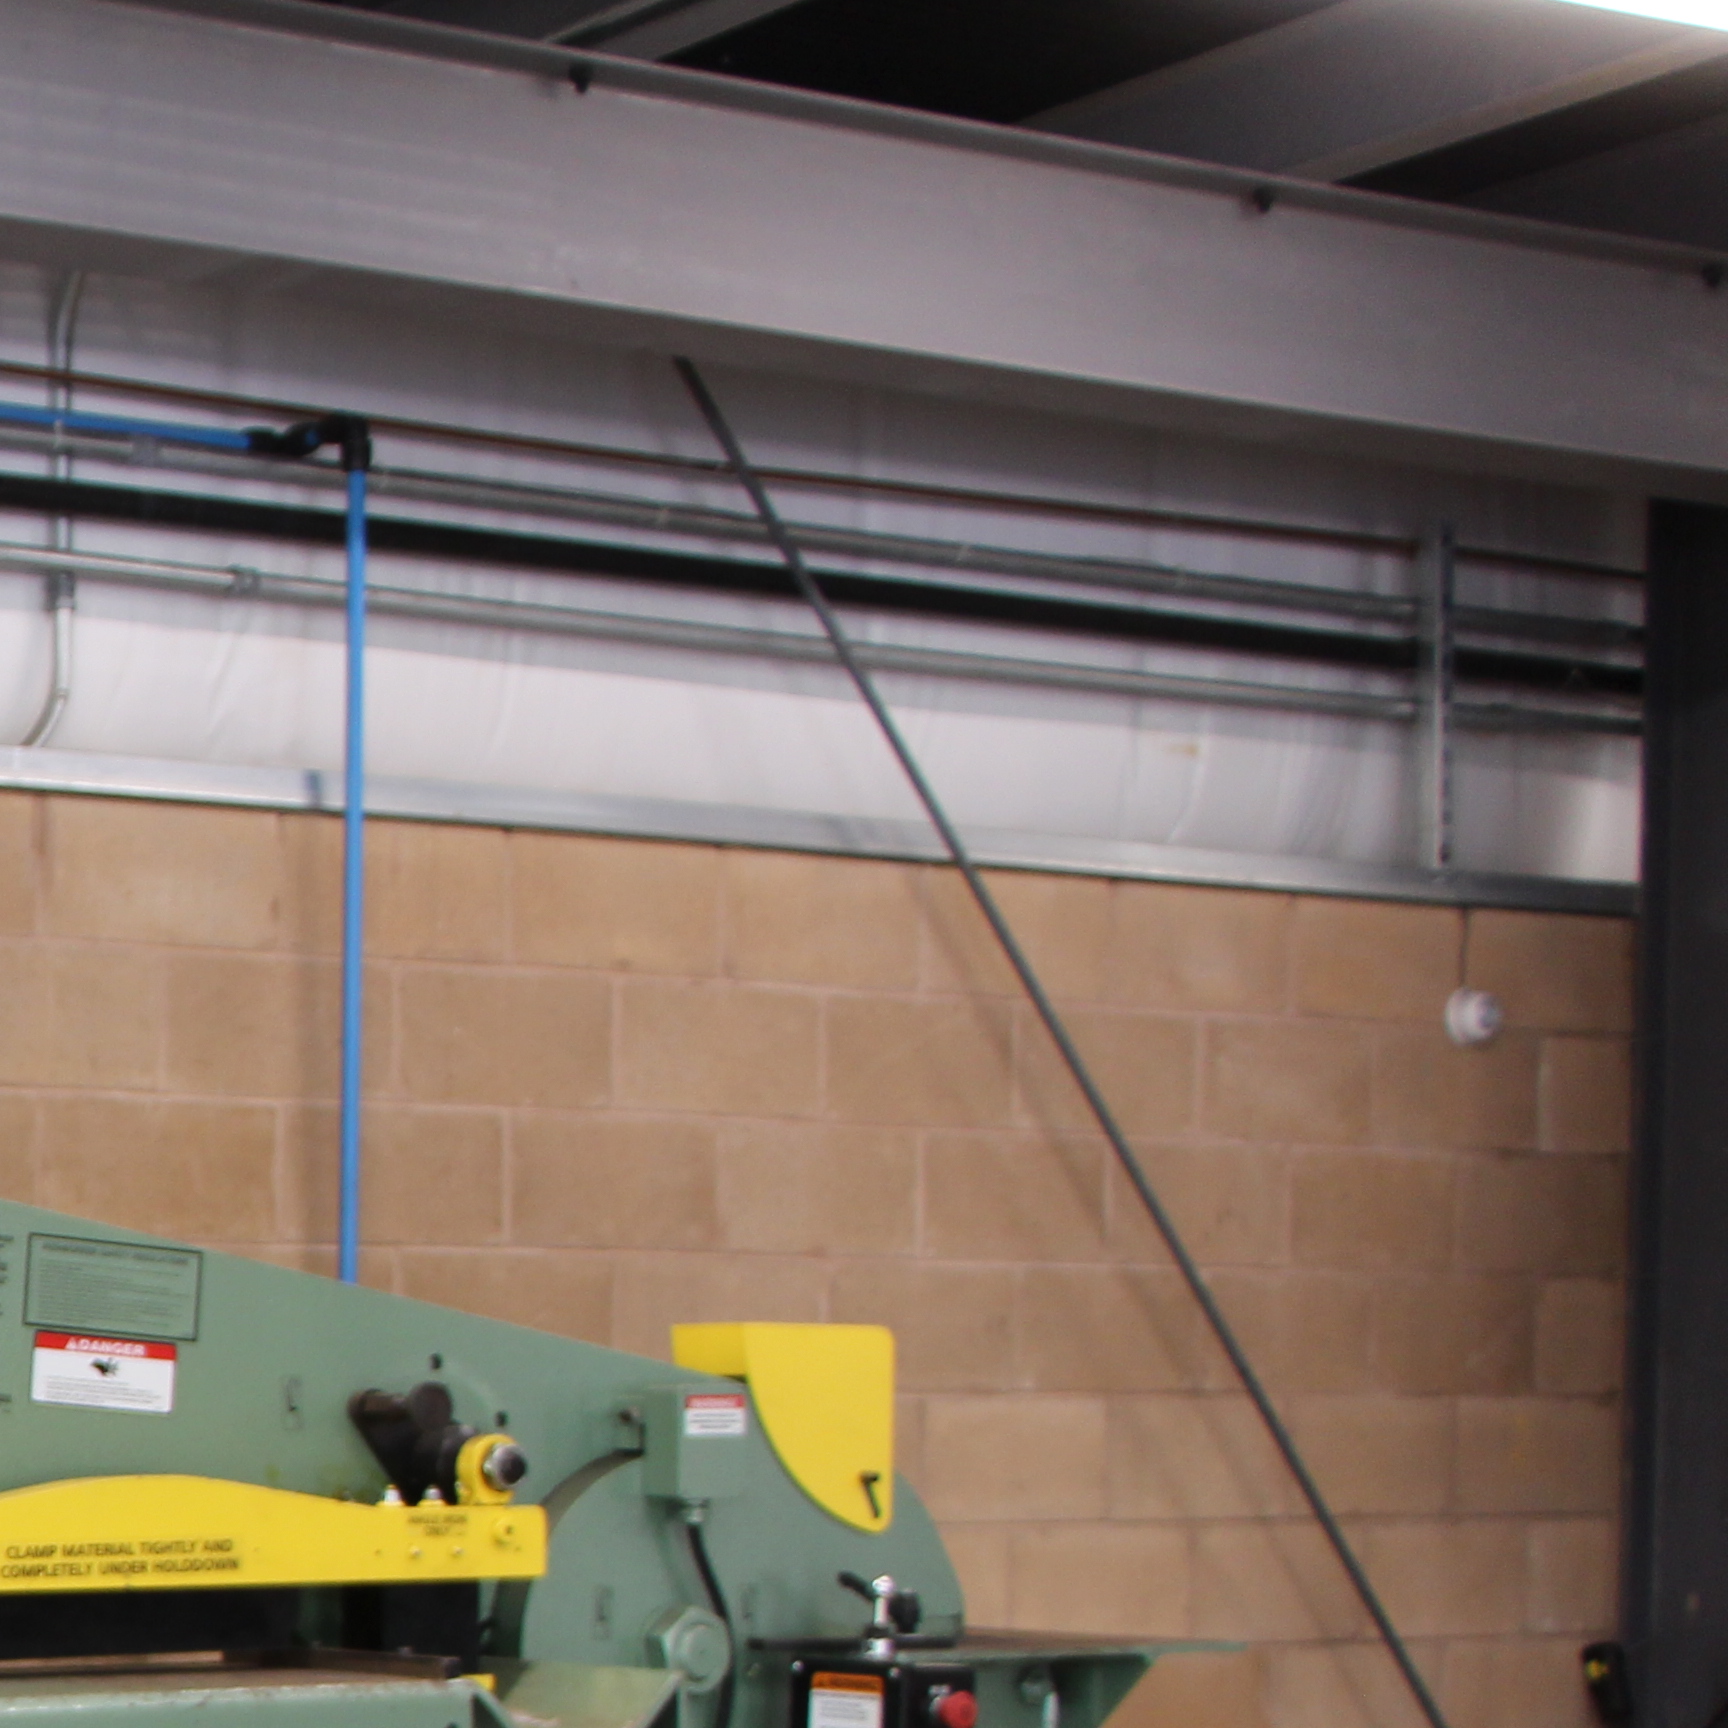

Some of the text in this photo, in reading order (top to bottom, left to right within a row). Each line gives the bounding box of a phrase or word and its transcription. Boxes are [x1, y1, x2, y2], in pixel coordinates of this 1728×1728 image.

[79, 1338, 145, 1356] DANGER
[6, 1539, 233, 1558] CLAMP MATERIAL TIGHTLY AND
[1, 1563, 91, 1578] COMPLETELY
[99, 1560, 148, 1574] UNDER
